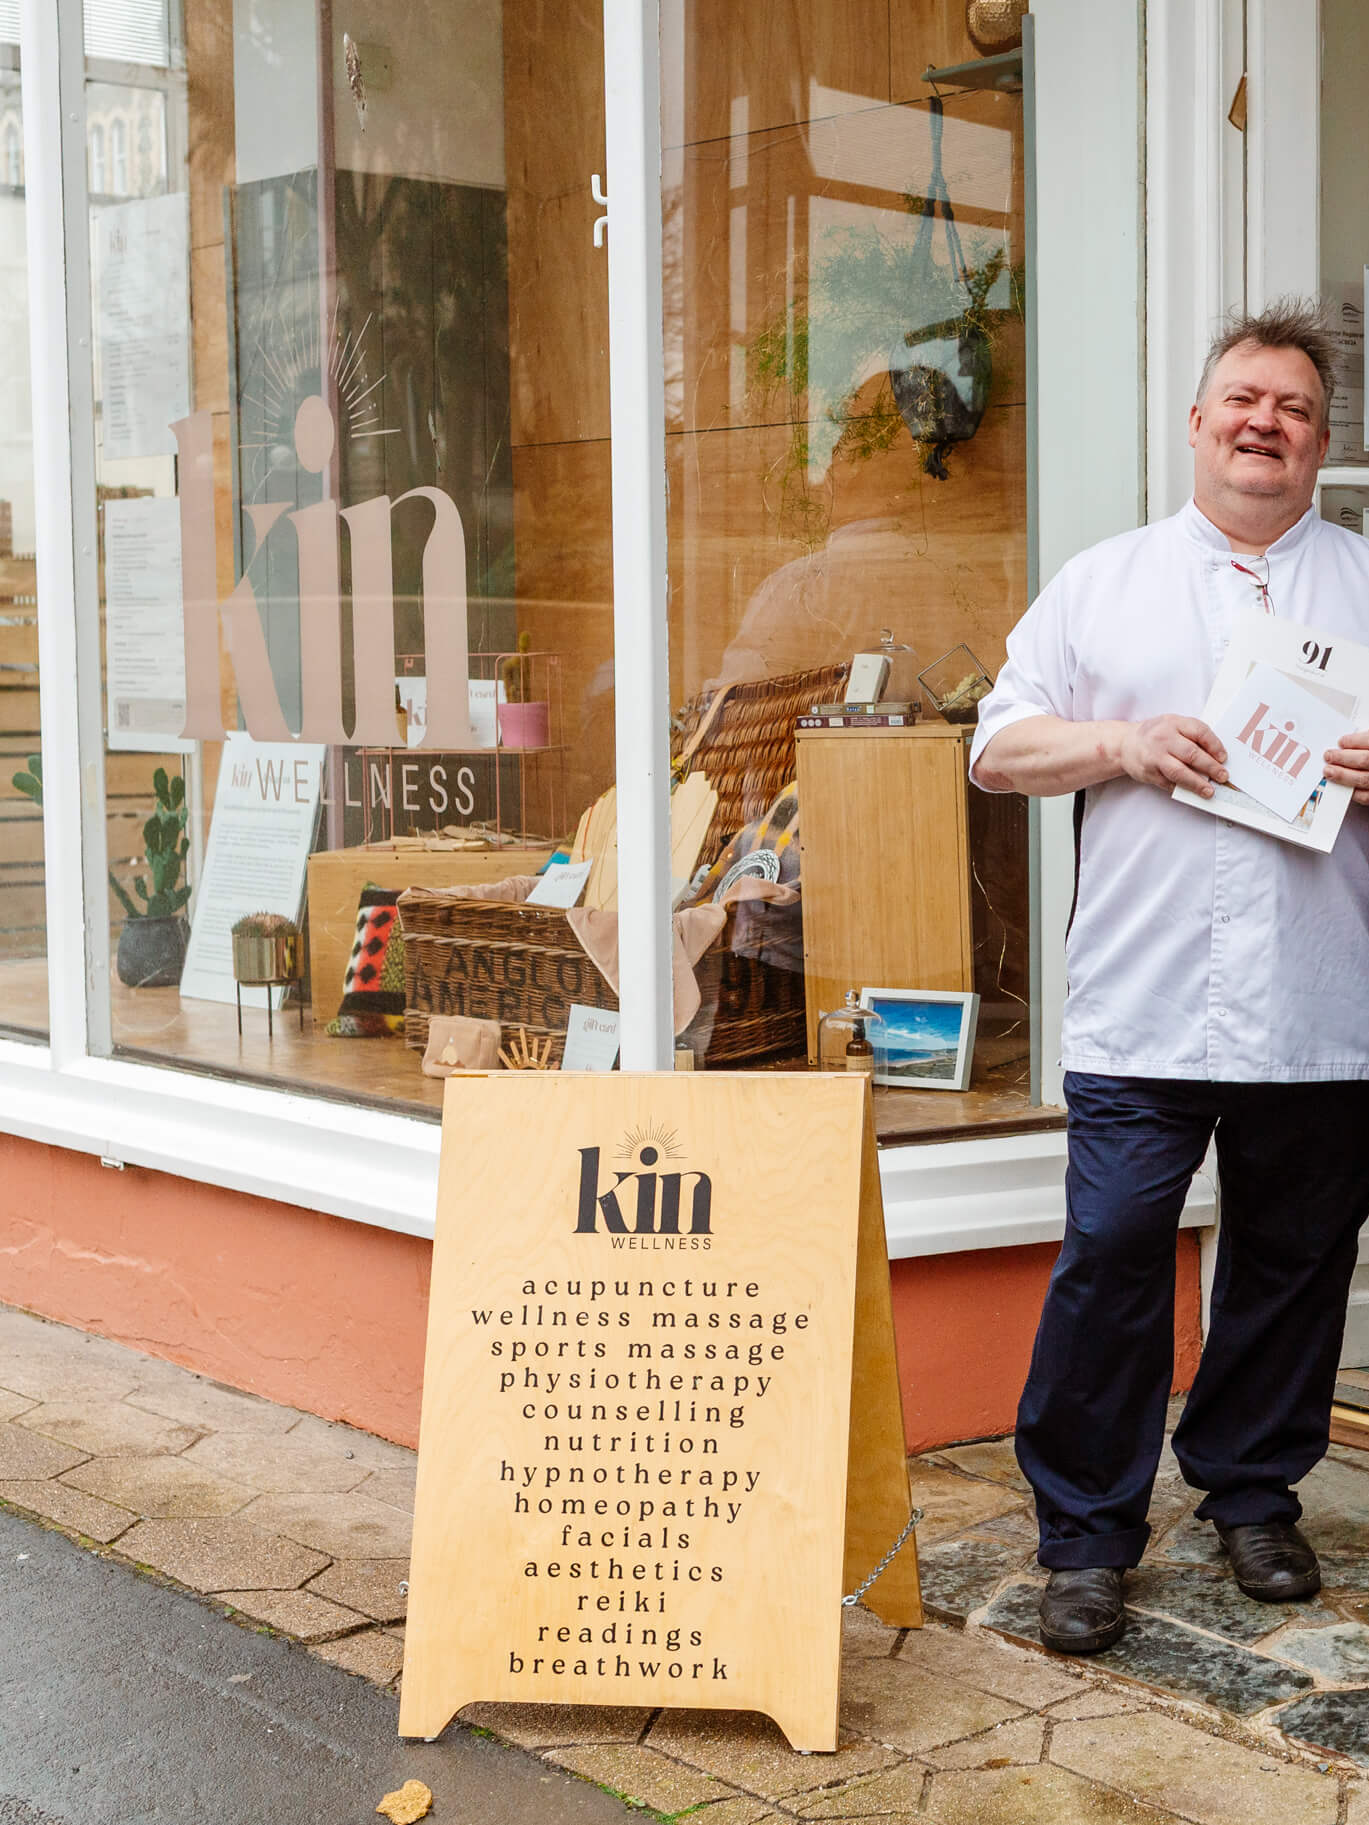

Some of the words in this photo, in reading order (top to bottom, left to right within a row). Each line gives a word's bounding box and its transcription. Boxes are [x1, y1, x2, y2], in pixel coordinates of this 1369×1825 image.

[167, 395, 482, 748] kin
[1302, 640, 1334, 671] 91
[1235, 702, 1311, 779] kin
[256, 758, 475, 815] WELLNESS
[445, 944, 583, 994] ANGLO
[572, 1146, 714, 1235] kin
[611, 1237, 712, 1250] WELLNESS
[521, 1278, 760, 1301] acupuncture
[471, 1305, 631, 1328] wellness
[651, 1312, 810, 1334] massage
[490, 1338, 606, 1362] sports
[628, 1343, 785, 1365] massage
[499, 1368, 772, 1398] physiotherapy
[521, 1400, 746, 1429] counselling
[543, 1431, 719, 1455] nutrition
[499, 1460, 762, 1492] hypnotherapy
[513, 1493, 743, 1524] homeopathy
[561, 1524, 690, 1550] facials
[523, 1557, 724, 1583] aesthetics
[577, 1590, 668, 1614] reiki
[537, 1622, 703, 1652] readings
[509, 1651, 729, 1682] breathwork
